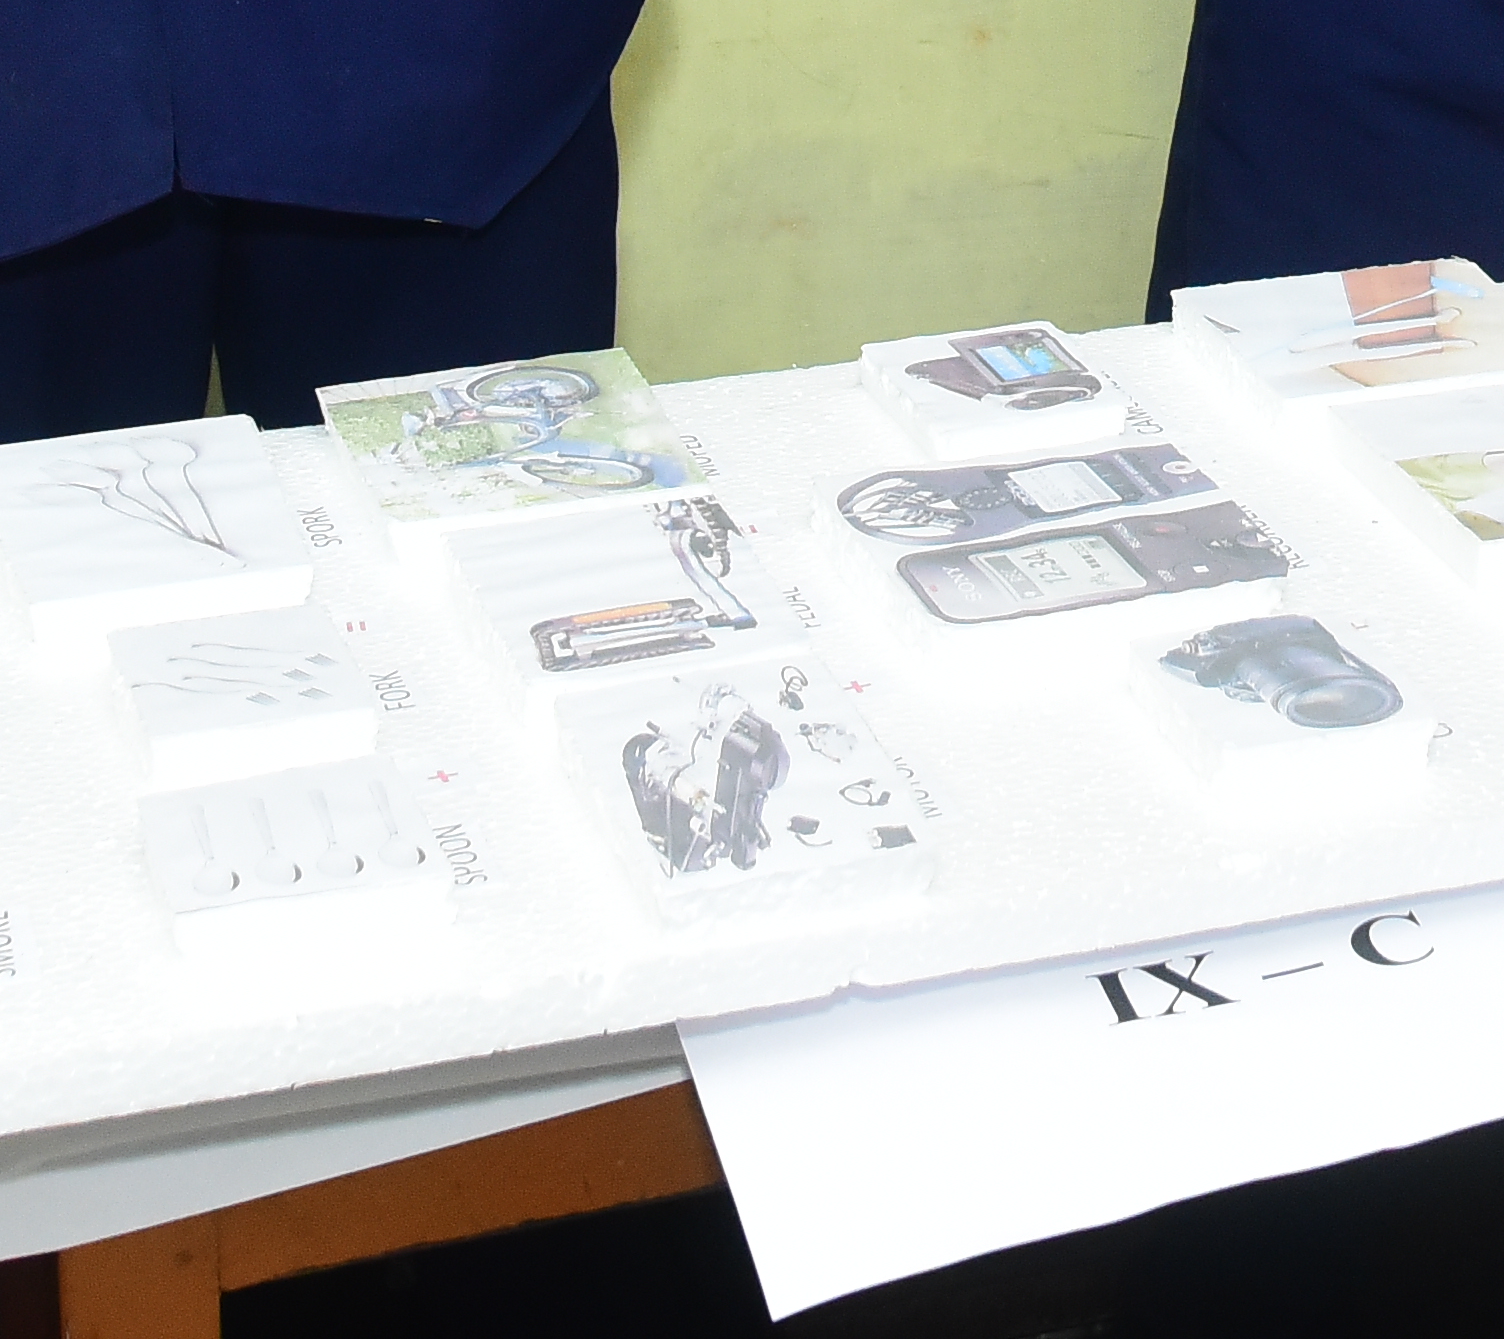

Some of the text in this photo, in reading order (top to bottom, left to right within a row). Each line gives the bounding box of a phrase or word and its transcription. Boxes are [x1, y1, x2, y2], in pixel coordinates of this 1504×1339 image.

[296, 505, 343, 549] SPORK
[368, 669, 417, 712] FORK
[1085, 951, 1240, 1027] IX
[1350, 909, 1436, 966] C
